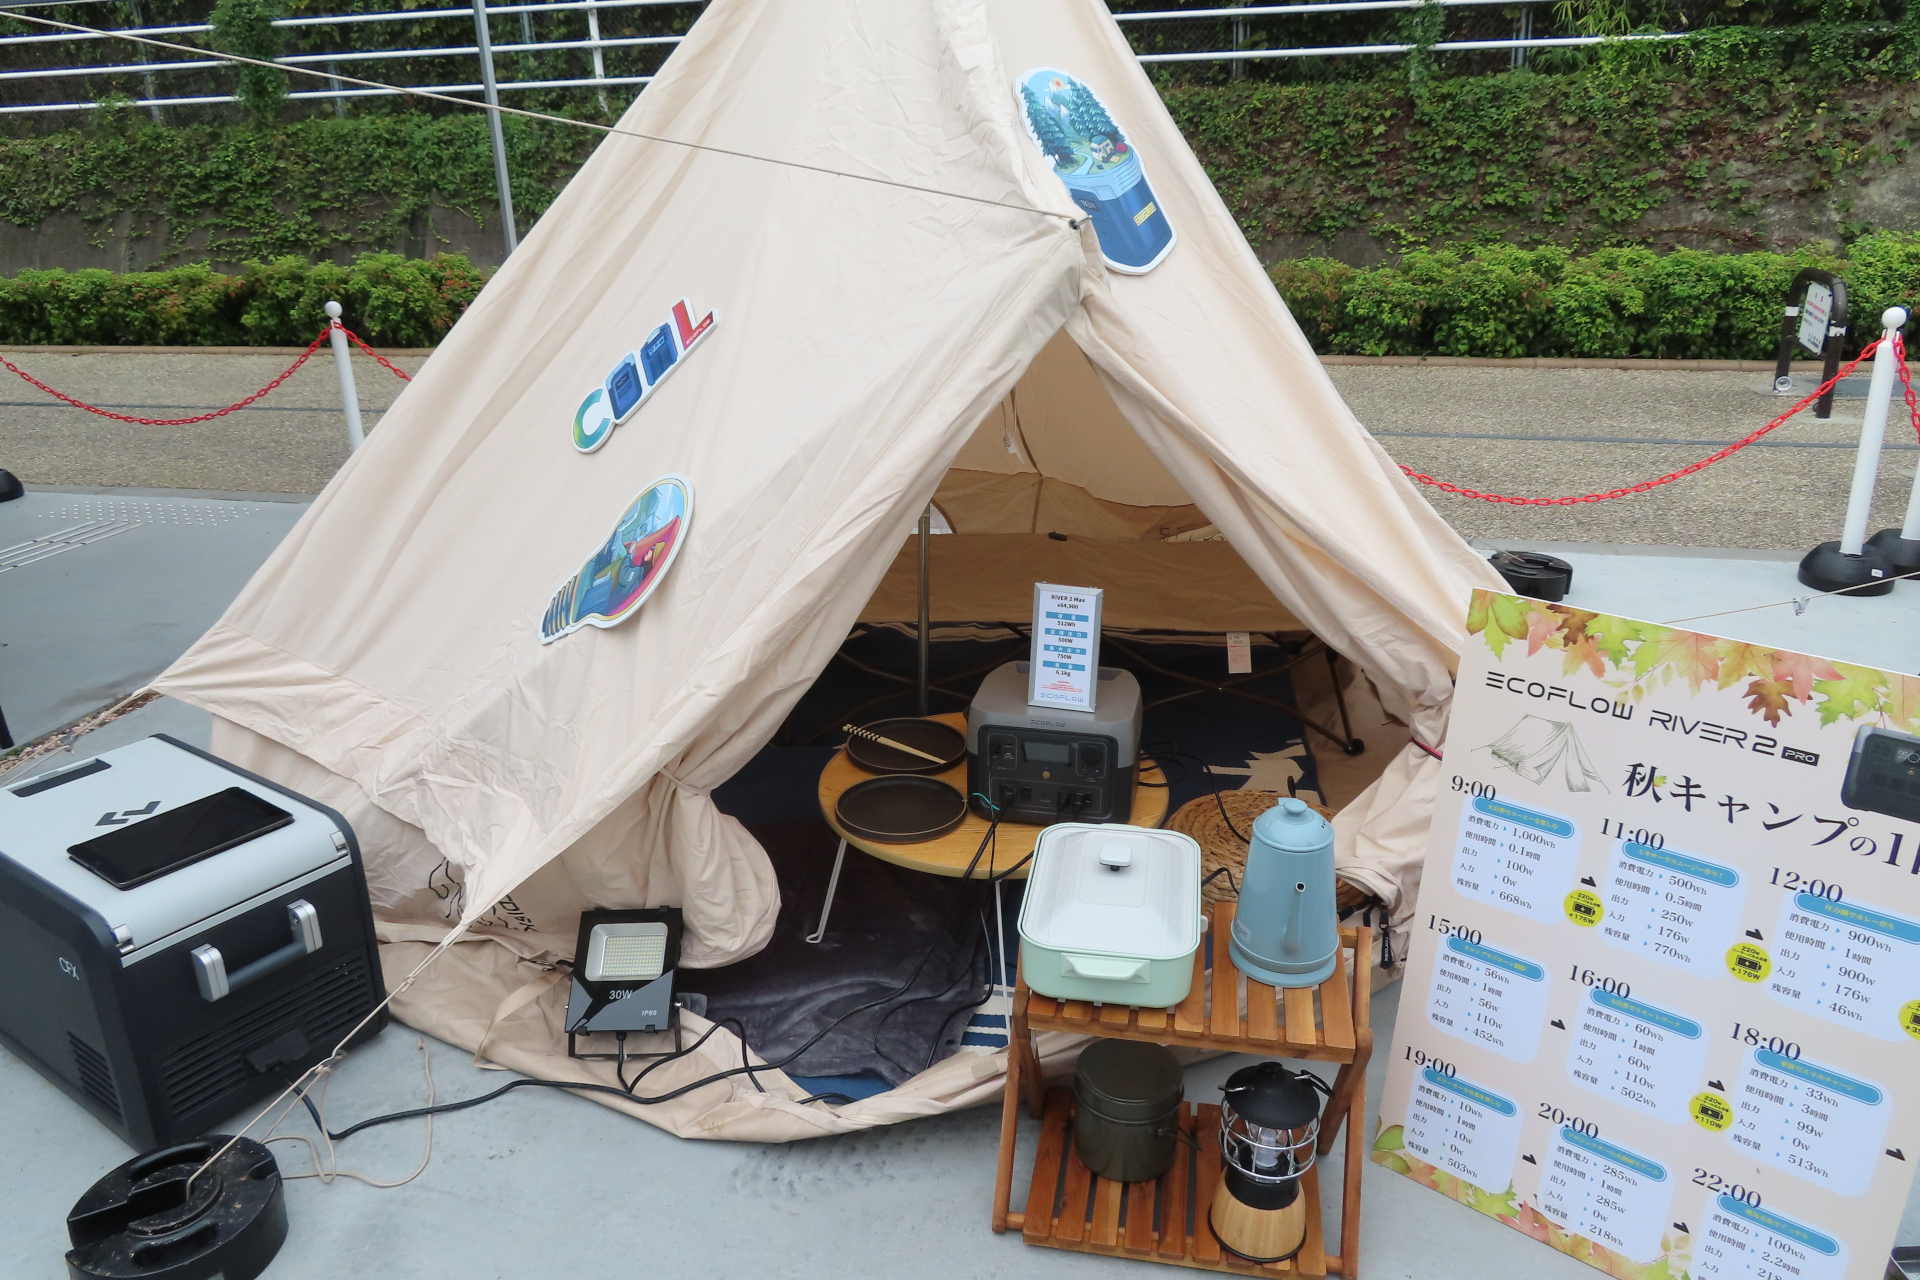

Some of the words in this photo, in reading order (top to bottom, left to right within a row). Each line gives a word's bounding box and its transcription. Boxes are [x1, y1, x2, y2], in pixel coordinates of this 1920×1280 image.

[1051, 594, 1068, 602] RIVER
[1057, 620, 1076, 628] 512Wh
[1055, 669, 1071, 677] 6.1kg
[1040, 692, 1084, 703] ECOFLOW
[1031, 720, 1066, 728] ECOFLOW
[1485, 671, 1633, 720] ECOFLOW
[1649, 710, 1748, 749] RIVER
[1752, 734, 1778, 756] 2
[1784, 748, 1818, 764] PRO
[1451, 775, 1496, 801] 9:00
[1468, 814, 1499, 831] 消費電力
[1621, 762, 1920, 875] 秋キャンプの1
[1465, 831, 1497, 847] 使用時間
[1509, 843, 1541, 861] 0.1時間
[1600, 818, 1664, 850] 11:00
[1462, 847, 1478, 857] 出力
[1619, 860, 1654, 878] 消費電力
[1669, 875, 1707, 896] 500Wh
[1769, 867, 1843, 903] 12:00
[1499, 891, 1532, 910] 668Wh
[1611, 894, 1629, 906] 出力
[1615, 877, 1651, 895] 使用時間
[1665, 892, 1702, 912] 0.5時間
[1428, 914, 1482, 946] 15:00
[1569, 912, 1594, 924] +176W
[1789, 912, 1830, 932] 消費電力
[1848, 930, 1891, 953] 900Wh
[1654, 942, 1691, 963] 770Wh
[1780, 948, 1800, 961] 出力
[1785, 930, 1826, 950] 使用時間
[1844, 948, 1872, 966] 1時間
[1442, 953, 1472, 970] 消費電力
[1484, 967, 1510, 985] 56Wh
[1569, 964, 1630, 999] 16:00
[1731, 966, 1761, 980] +176W
[609, 989, 633, 1000] 30W
[1436, 983, 1452, 995] 出力
[1439, 968, 1470, 986] 使用時間
[1482, 983, 1502, 998] 1時間
[1586, 1006, 1620, 1025] 消費電力
[1635, 1023, 1664, 1042] 60Wh
[1828, 1002, 1862, 1022] 46Wh
[1472, 1028, 1504, 1047] 452Wh
[1580, 1038, 1596, 1051] 出力
[1583, 1022, 1617, 1041] 使用時間
[1632, 1039, 1655, 1056] 1時間
[1730, 1022, 1800, 1060] 18:00
[1404, 1046, 1456, 1078] 19:00
[1620, 1086, 1656, 1109] 502Wh
[1749, 1067, 1788, 1088] 消費電力
[1805, 1087, 1839, 1108] 33Wh
[1415, 1099, 1445, 1117] 使用時間
[1456, 1115, 1476, 1131] 1時間
[1418, 1085, 1447, 1102] 消費電力
[1459, 1101, 1483, 1119] 10Wh
[1741, 1101, 1760, 1114] 出力
[1745, 1084, 1785, 1106] 使用時間
[1801, 1103, 1829, 1122] 3時間
[1412, 1113, 1427, 1124] 出力
[1538, 1102, 1599, 1139] 20:00
[1694, 1115, 1723, 1129] +110W
[1447, 1157, 1478, 1179] 503Wh
[1553, 1159, 1586, 1180] 使用時間
[1600, 1179, 1623, 1197] 1時間
[1556, 1144, 1589, 1165] 消費電力
[1602, 1164, 1638, 1187] 285Wh
[1788, 1153, 1829, 1179] 513Wh
[1550, 1175, 1567, 1187] 出力
[1692, 1168, 1761, 1209] 22:00
[1589, 1224, 1624, 1247] 218Wh
[1712, 1213, 1750, 1235] 消費電力
[1767, 1236, 1806, 1261] 100Wh
[1705, 1244, 1723, 1258] 出力
[1709, 1229, 1746, 1251] 使用時間
[1761, 1251, 1801, 1276] 2.2時間
